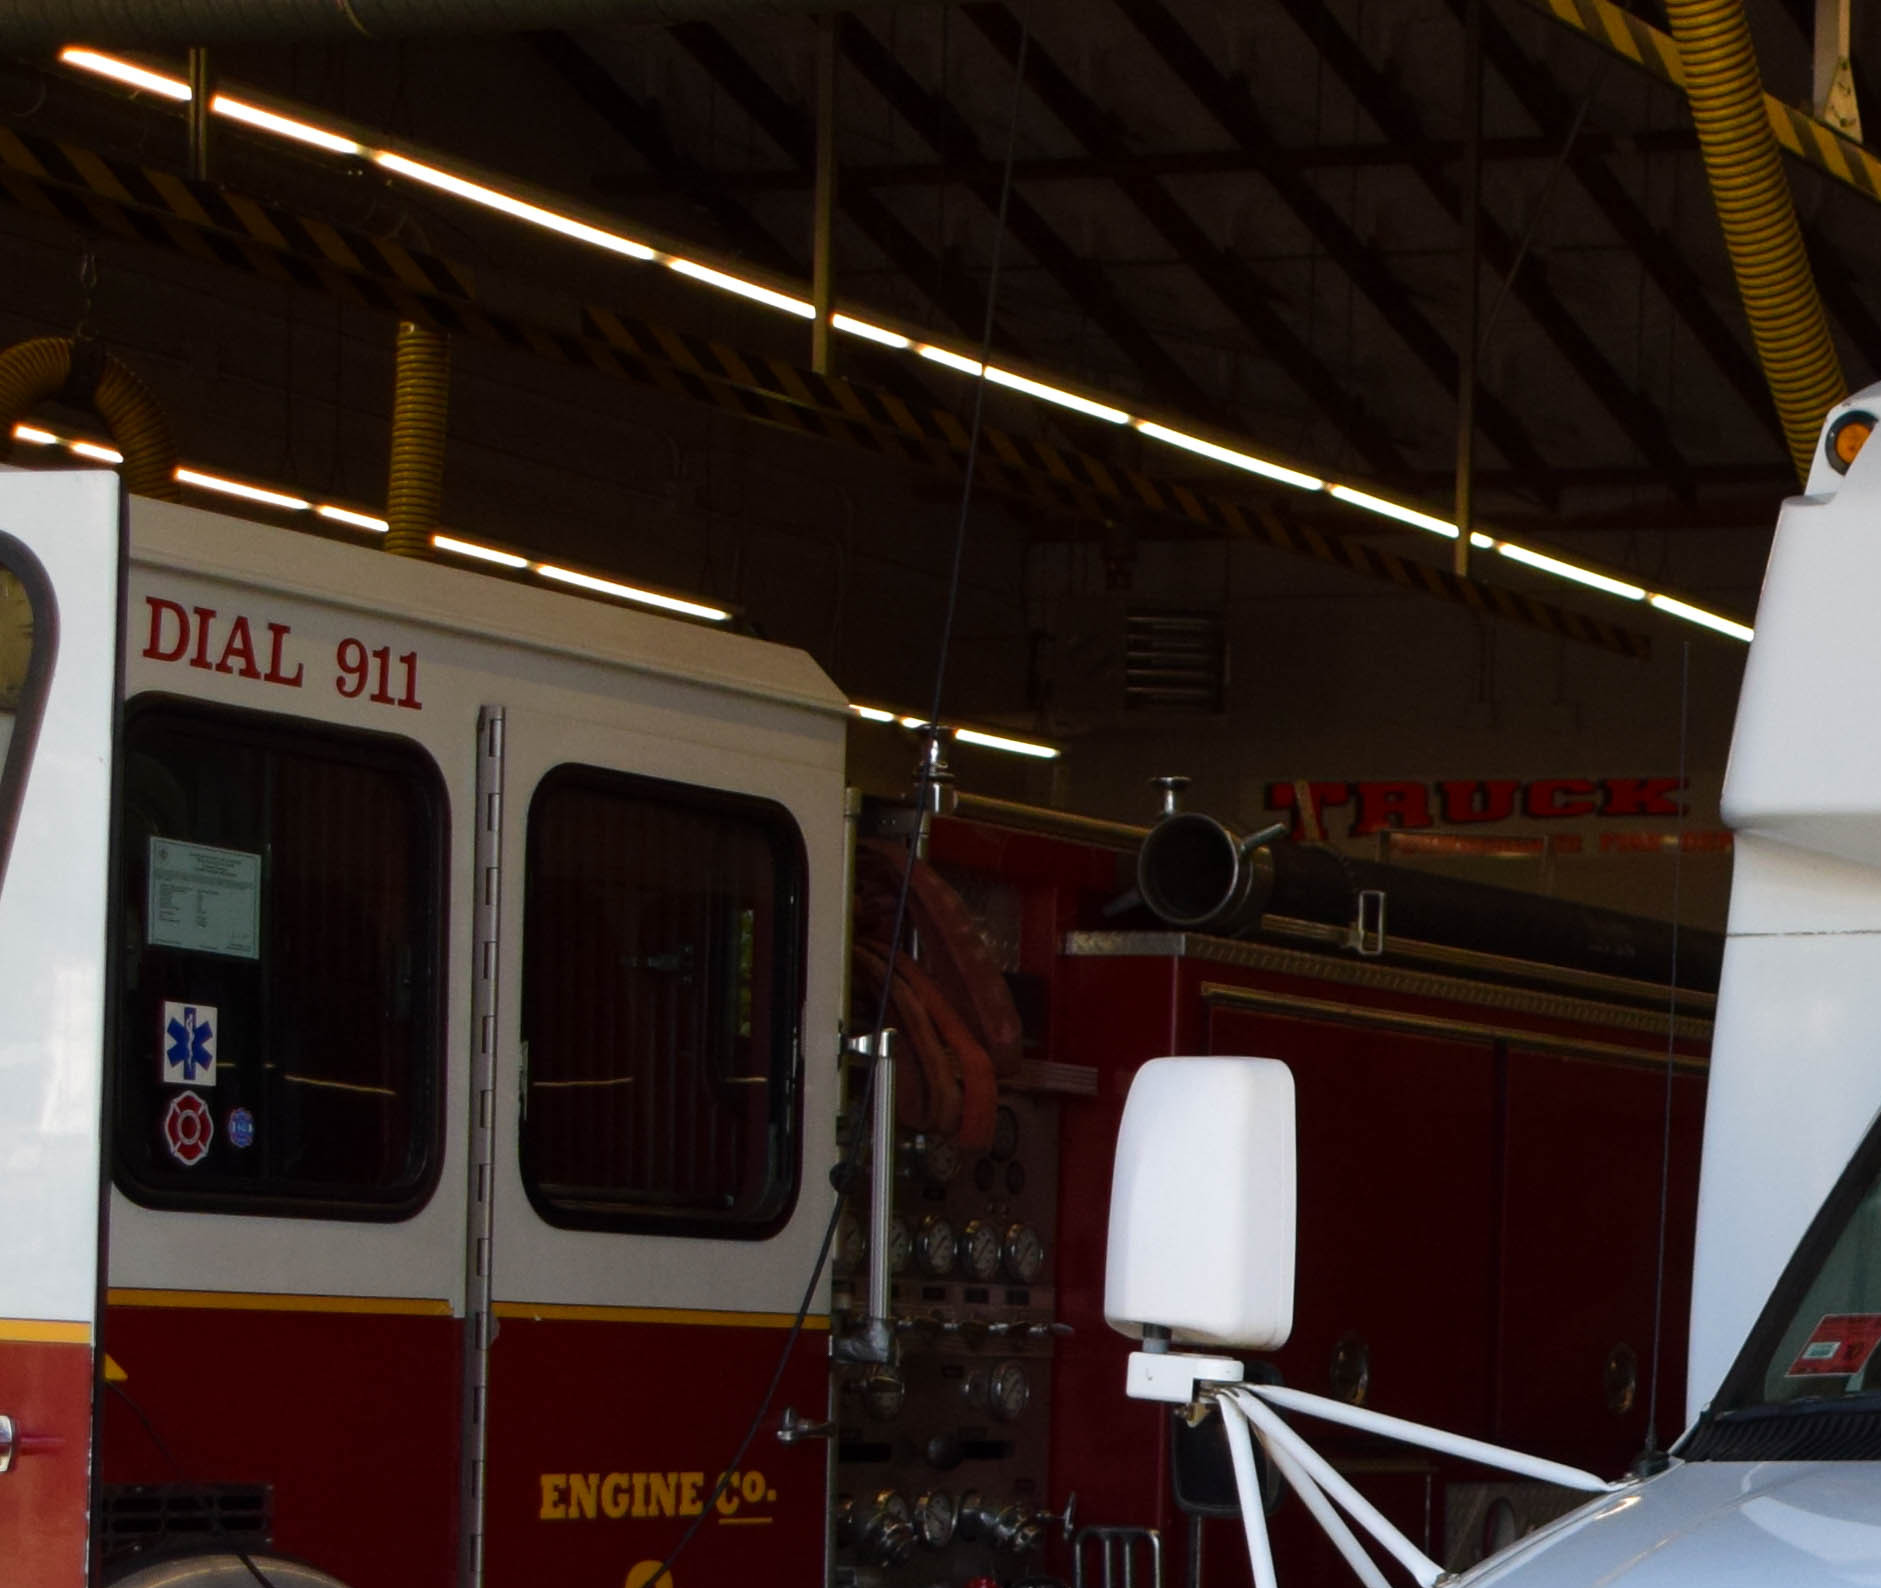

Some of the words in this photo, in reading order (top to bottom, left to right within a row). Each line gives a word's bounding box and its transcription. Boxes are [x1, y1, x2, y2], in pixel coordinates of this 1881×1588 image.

[142, 596, 304, 688] DIAL
[335, 637, 423, 710] 911
[1265, 777, 1690, 842] TRUCK
[538, 1471, 705, 1521] ENGINE
